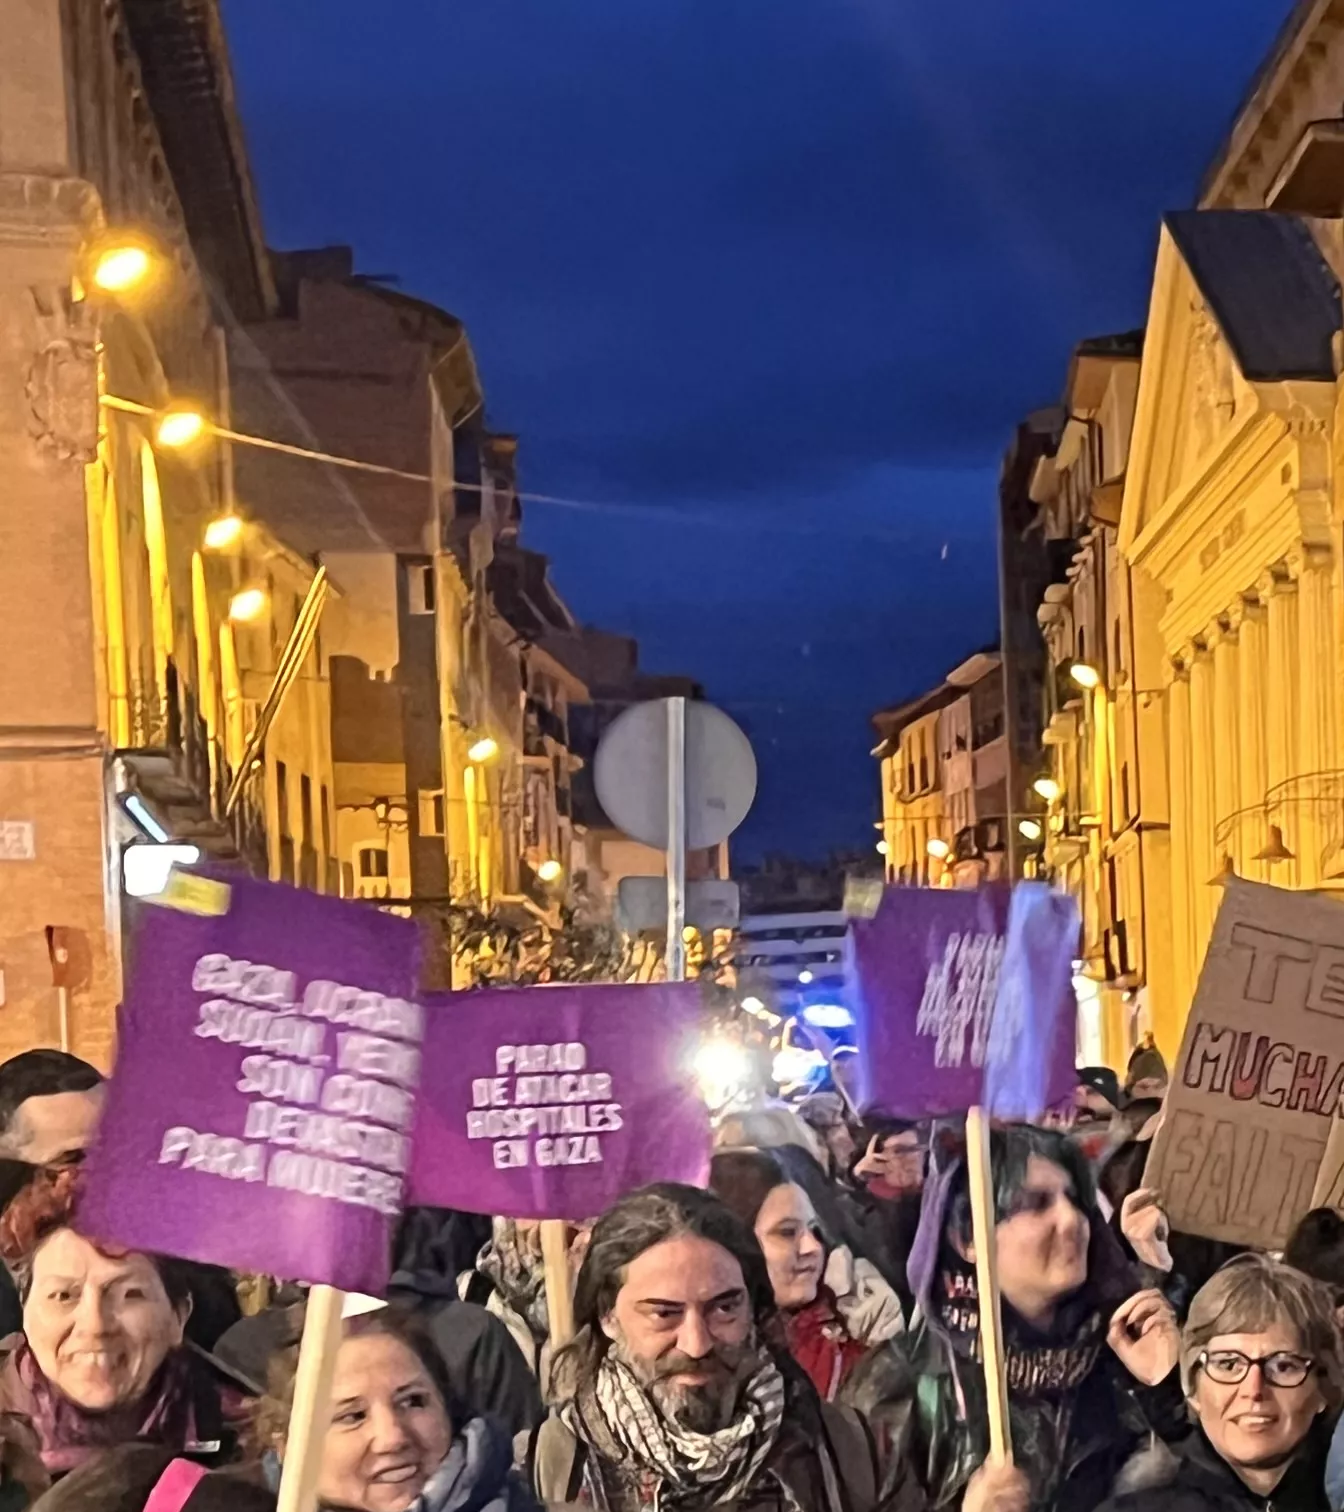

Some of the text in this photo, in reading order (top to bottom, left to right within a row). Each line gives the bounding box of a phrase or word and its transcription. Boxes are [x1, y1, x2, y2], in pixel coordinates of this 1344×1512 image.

[472, 1077, 510, 1107] DE
[466, 1103, 624, 1139] HOSPITALES
[535, 1135, 603, 1166] GAZA
